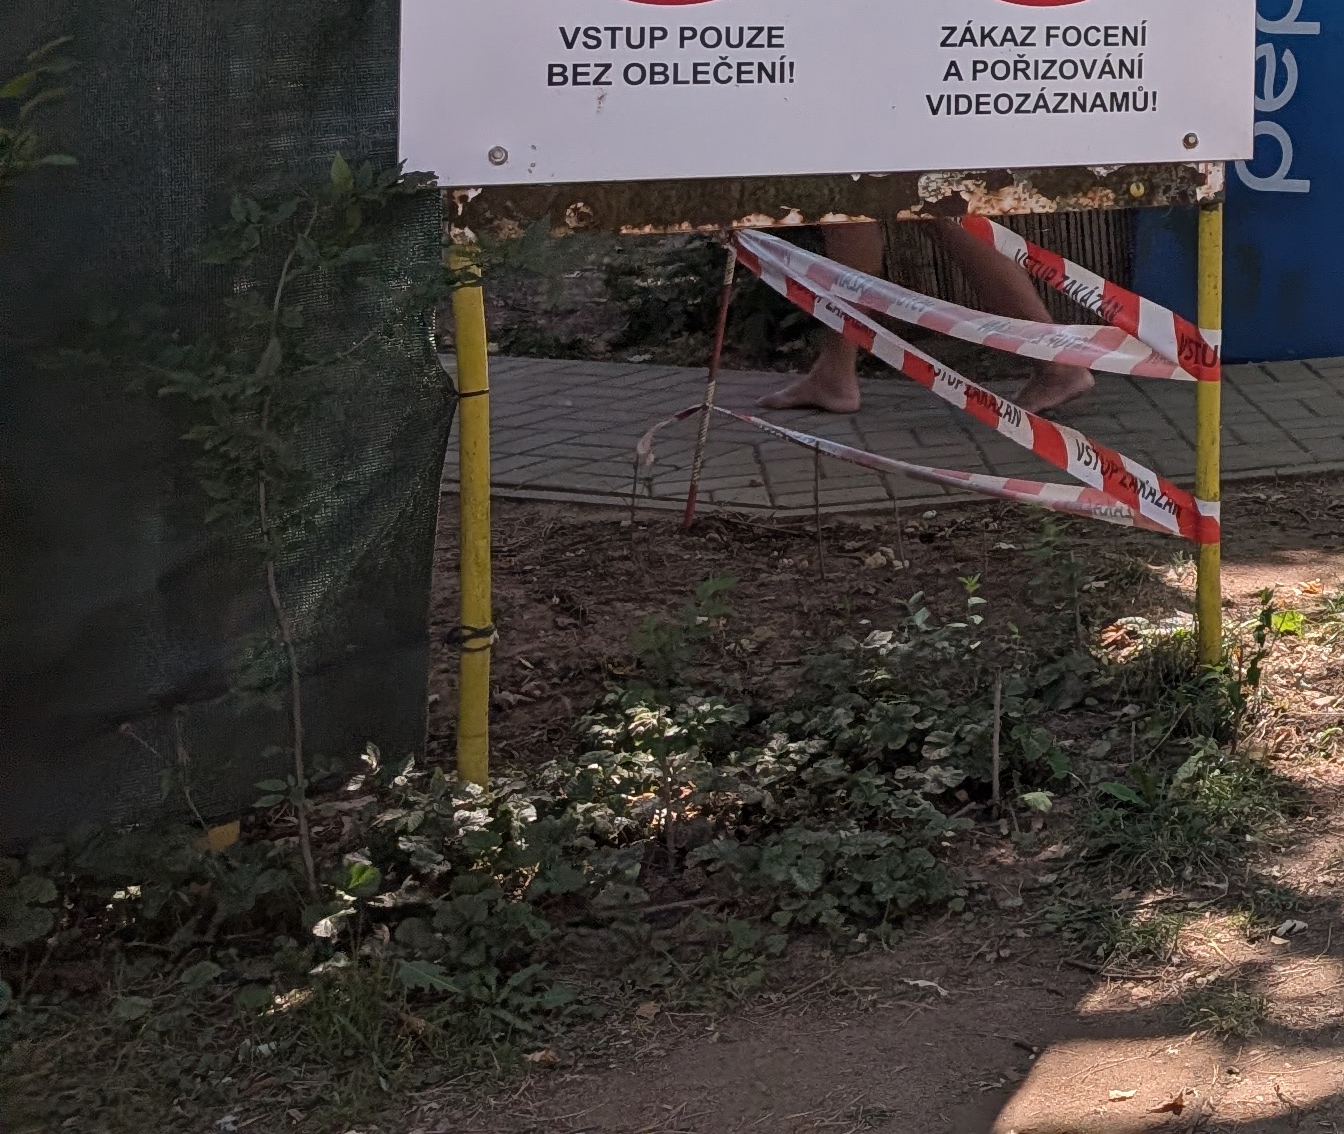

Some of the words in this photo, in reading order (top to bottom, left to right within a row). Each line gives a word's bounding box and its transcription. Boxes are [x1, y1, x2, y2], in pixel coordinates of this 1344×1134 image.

[558, 26, 668, 50] VSTUP
[679, 26, 785, 49] POUZE
[940, 20, 1036, 47] ZÁKAZ
[1046, 20, 1147, 47] FOCENÍ
[548, 63, 612, 86] BEZ
[623, 55, 795, 86] OBLEČENÍ!
[943, 60, 963, 81] A
[972, 53, 1144, 81] POŘIZOVÁNÍ
[926, 86, 1157, 116] VIDEOZÁZNAMŮ!
[1177, 333, 1218, 369] VSTU
[1075, 438, 1119, 478] VSTUP
